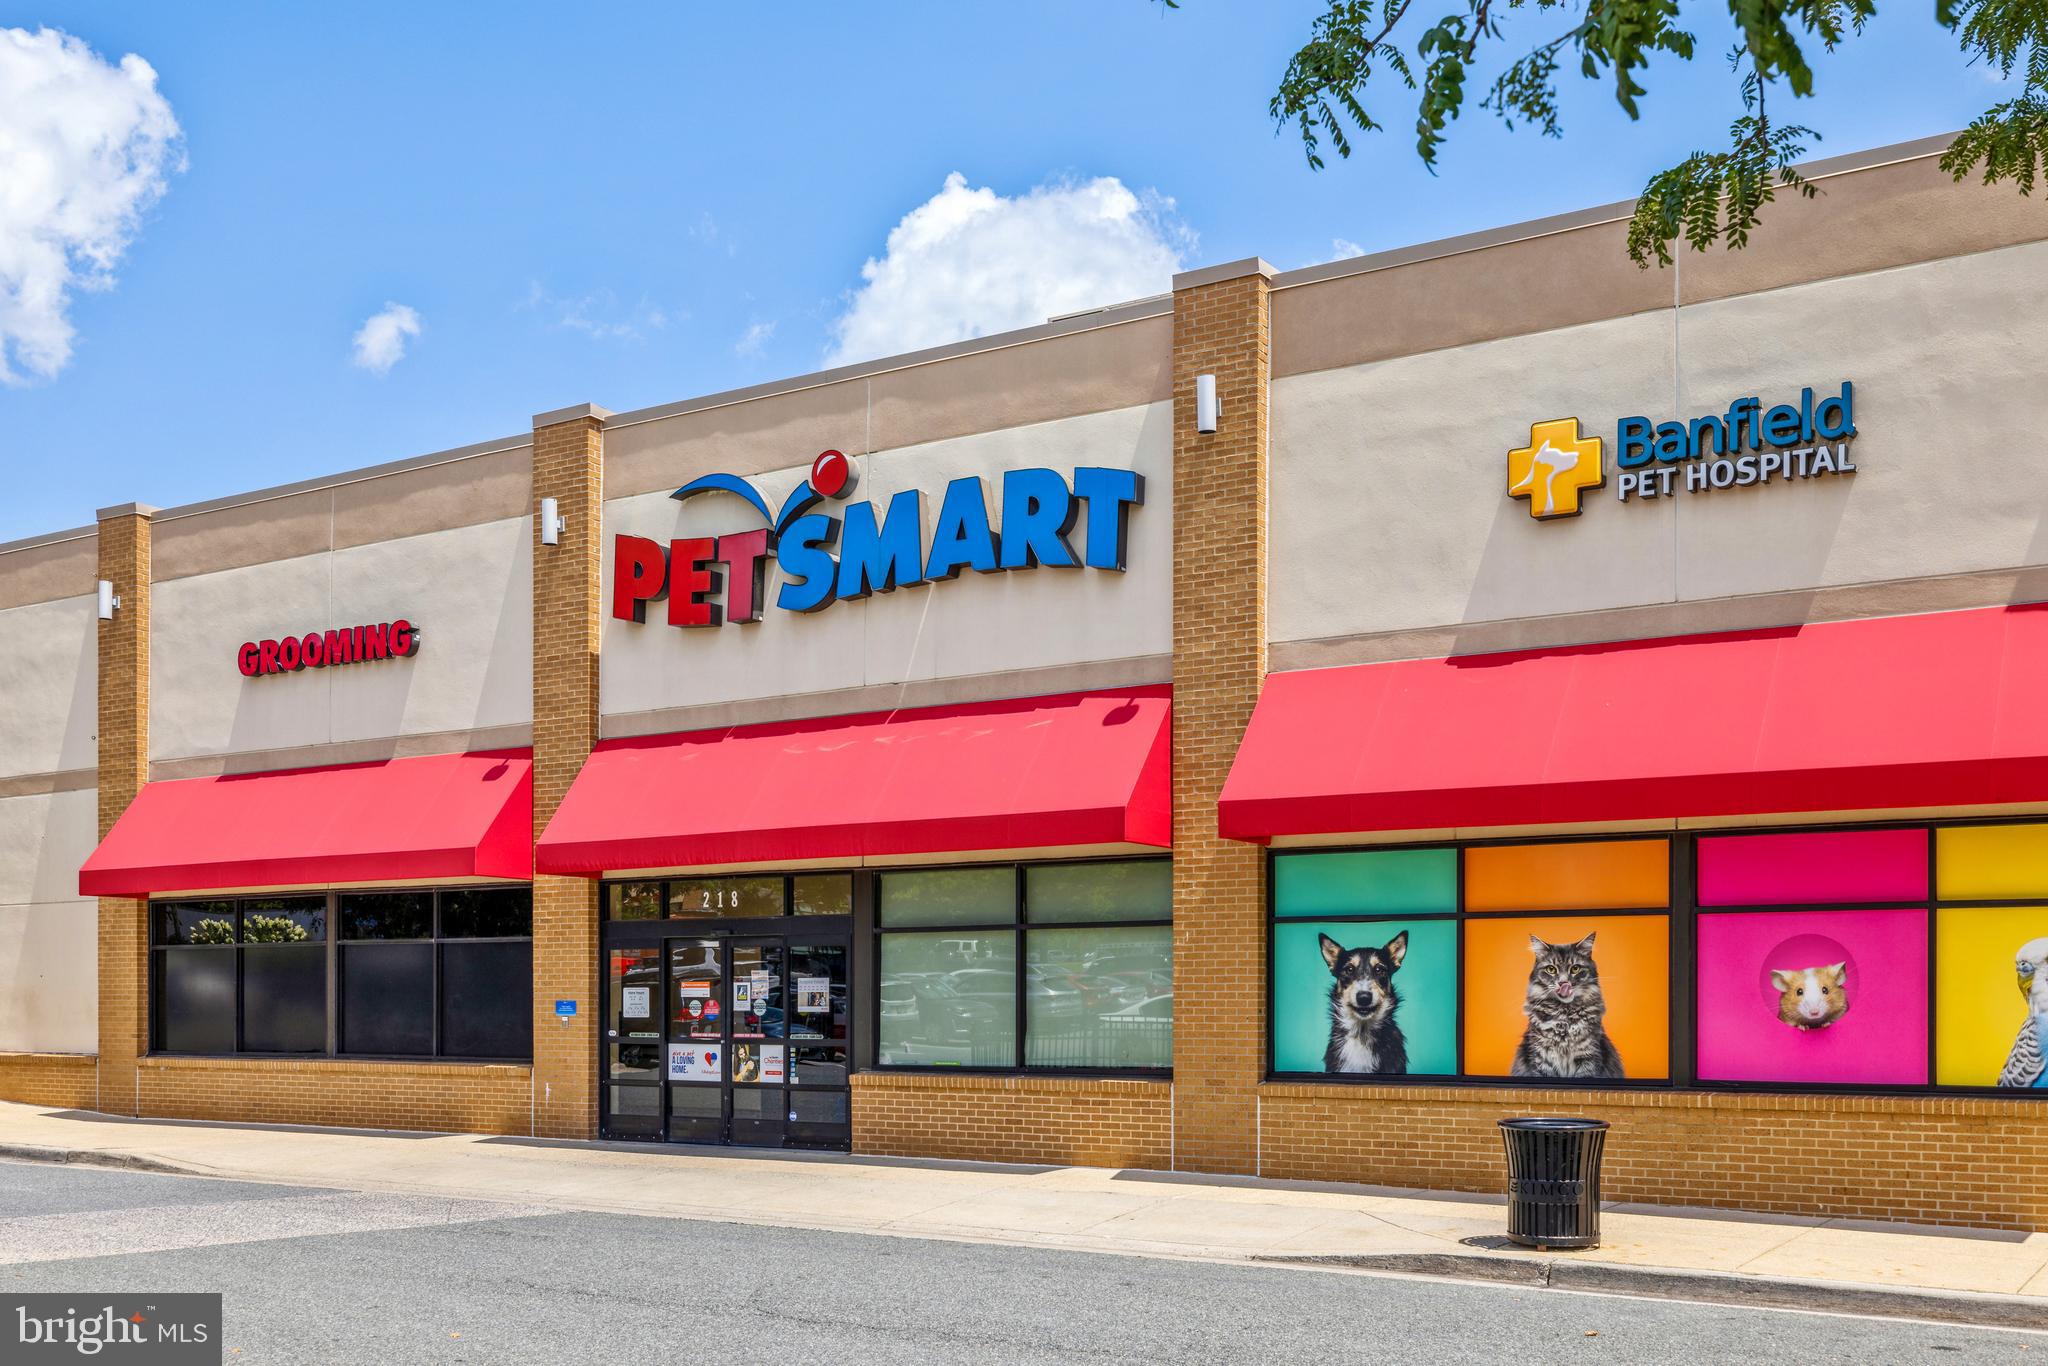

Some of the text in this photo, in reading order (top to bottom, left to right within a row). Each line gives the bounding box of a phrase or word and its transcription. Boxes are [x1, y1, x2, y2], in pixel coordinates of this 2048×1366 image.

[1617, 381, 1858, 469] Banfield
[1617, 443, 1859, 502] PET HOSPITAL
[612, 466, 1145, 628] PETSMART
[238, 619, 420, 677] GROOMING
[703, 890, 738, 908] 218
[672, 1056, 695, 1064] A LOVING
[1519, 1182, 1585, 1197] KIMCO
